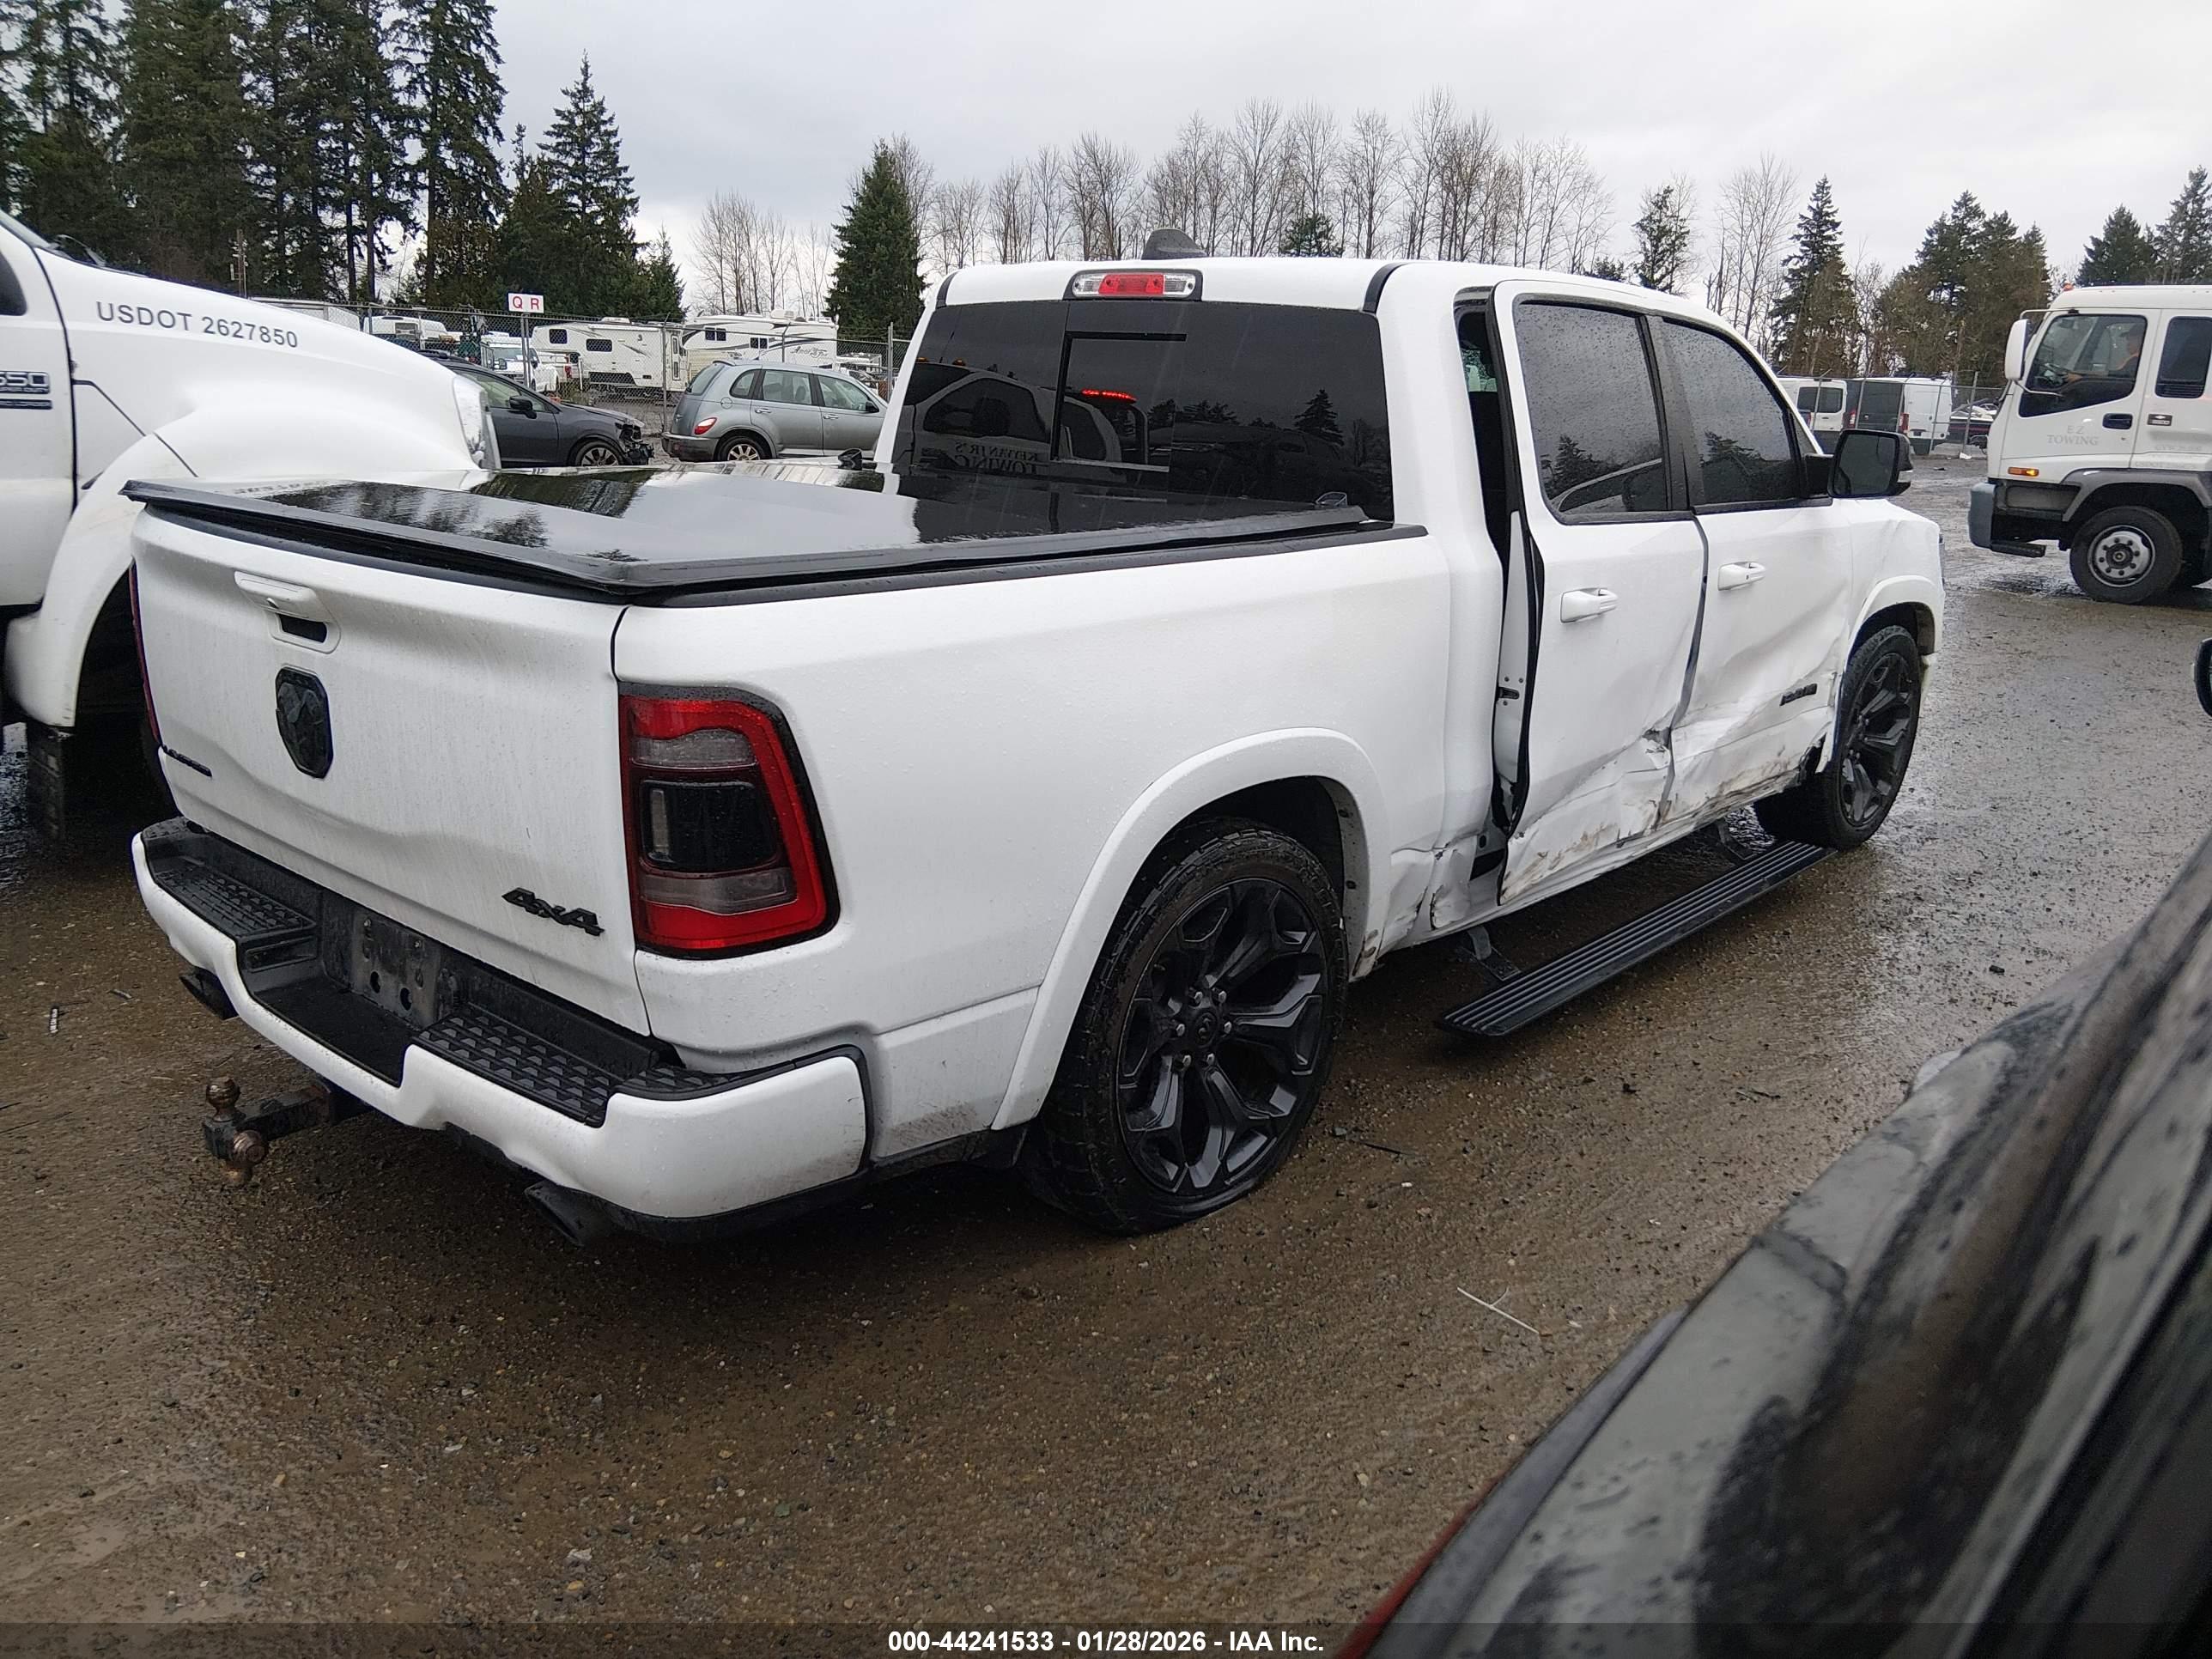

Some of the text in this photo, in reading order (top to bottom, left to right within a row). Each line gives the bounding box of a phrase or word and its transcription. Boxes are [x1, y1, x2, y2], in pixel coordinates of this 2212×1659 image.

[513, 296, 539, 310] Q R
[96, 301, 298, 348] USDOT 2627850
[2046, 434, 2100, 446] TOWING
